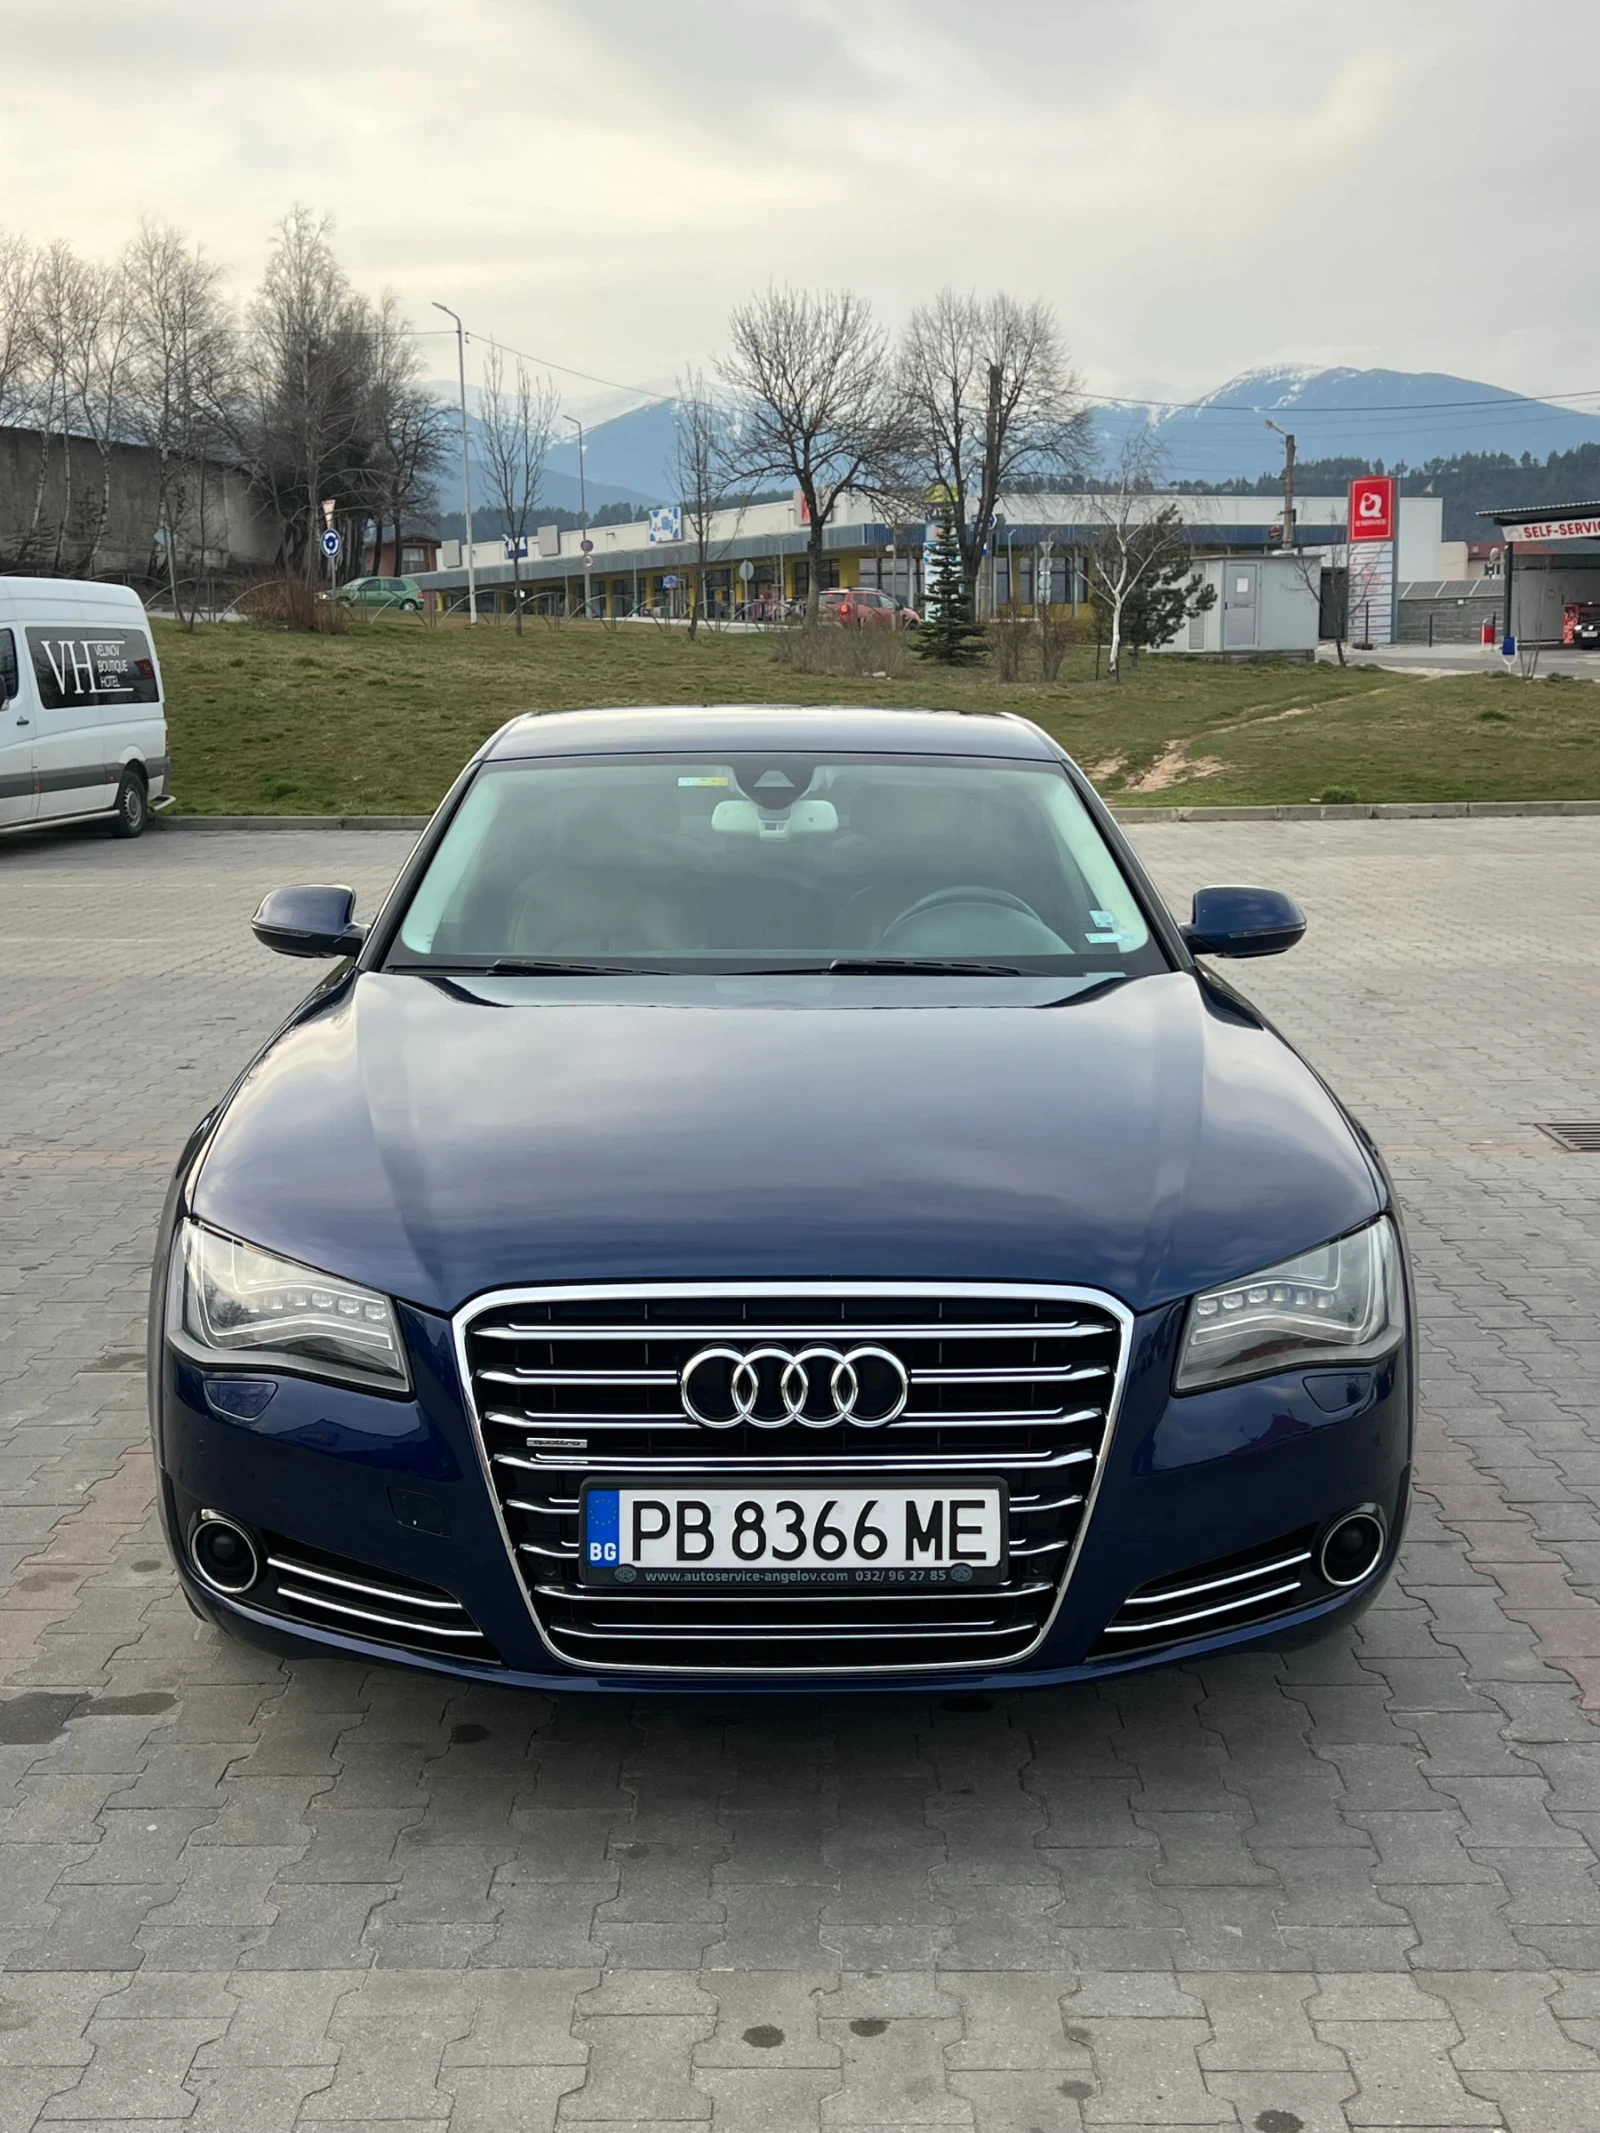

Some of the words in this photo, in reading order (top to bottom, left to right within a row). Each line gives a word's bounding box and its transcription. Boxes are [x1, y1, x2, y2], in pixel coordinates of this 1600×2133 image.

[40, 640, 98, 695] VH
[97, 659, 128, 674] BOUTIQUE
[100, 675, 121, 688] HOTEL
[533, 1439, 581, 1447] quattro
[632, 1500, 715, 1561] PB
[731, 1500, 888, 1561] 8366
[905, 1500, 987, 1561] ME
[589, 1542, 617, 1561] BG
[645, 1570, 849, 1584] www.autoservice-angelov.com
[855, 1570, 885, 1582] 032/
[888, 1570, 905, 1581] 96
[909, 1570, 925, 1581] 27
[929, 1570, 947, 1581] 85
